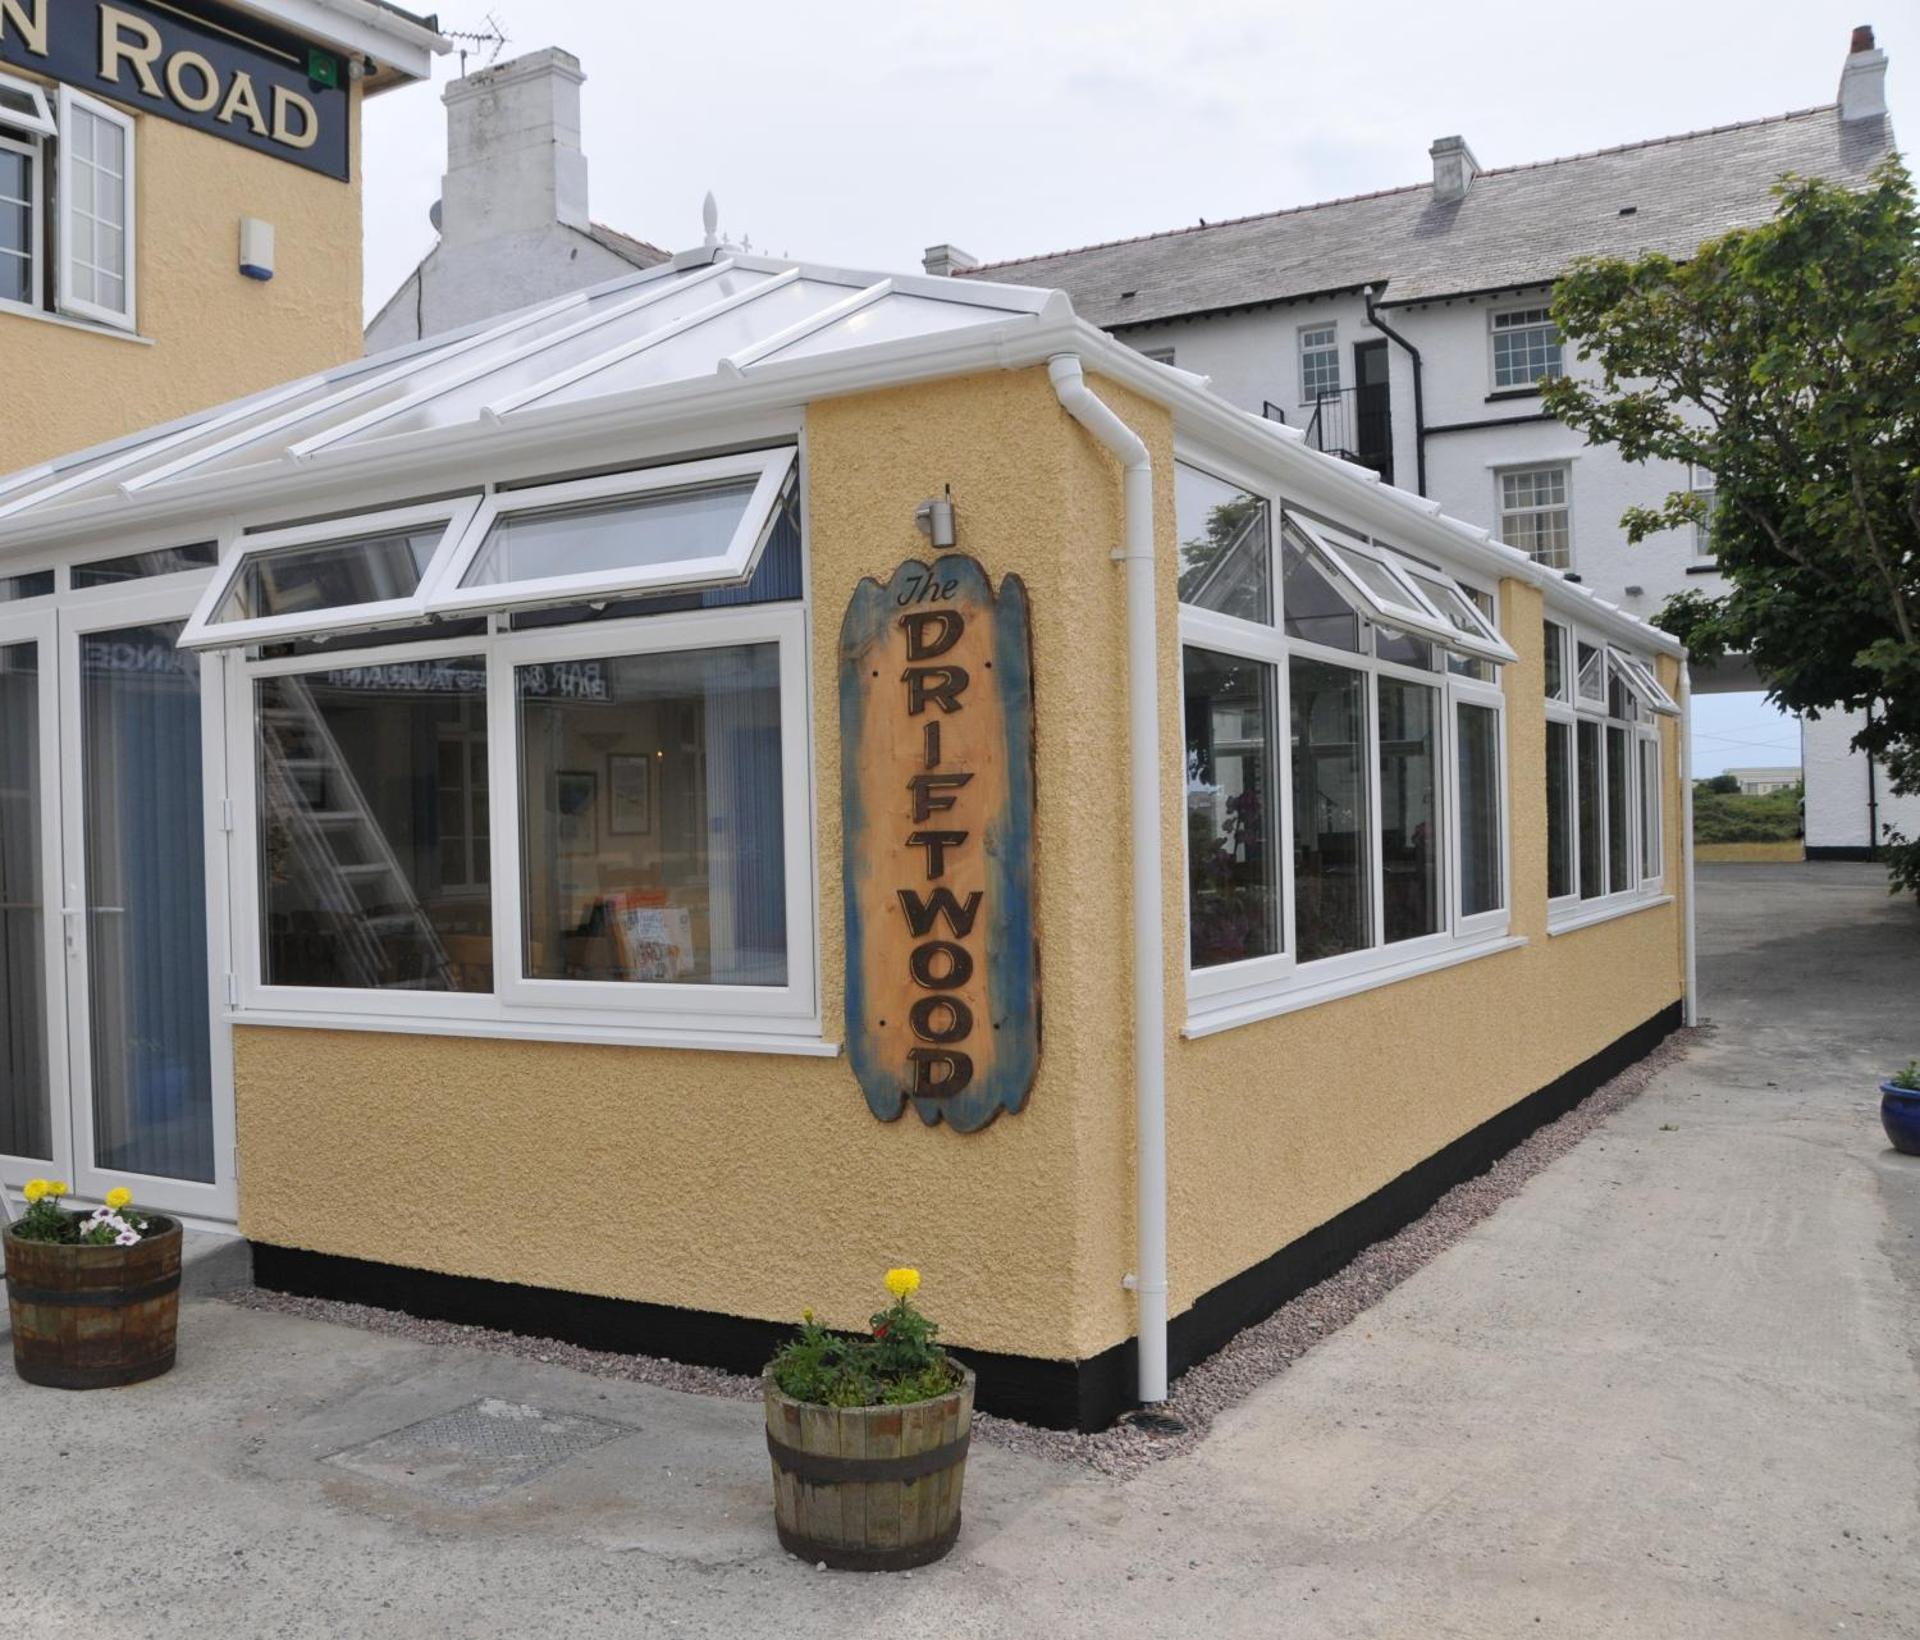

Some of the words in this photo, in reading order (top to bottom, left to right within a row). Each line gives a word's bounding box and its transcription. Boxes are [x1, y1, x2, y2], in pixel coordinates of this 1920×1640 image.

[99, 4, 319, 149] ROAD
[897, 572, 959, 606] The
[897, 609, 984, 1098] DRIFTWOOD
